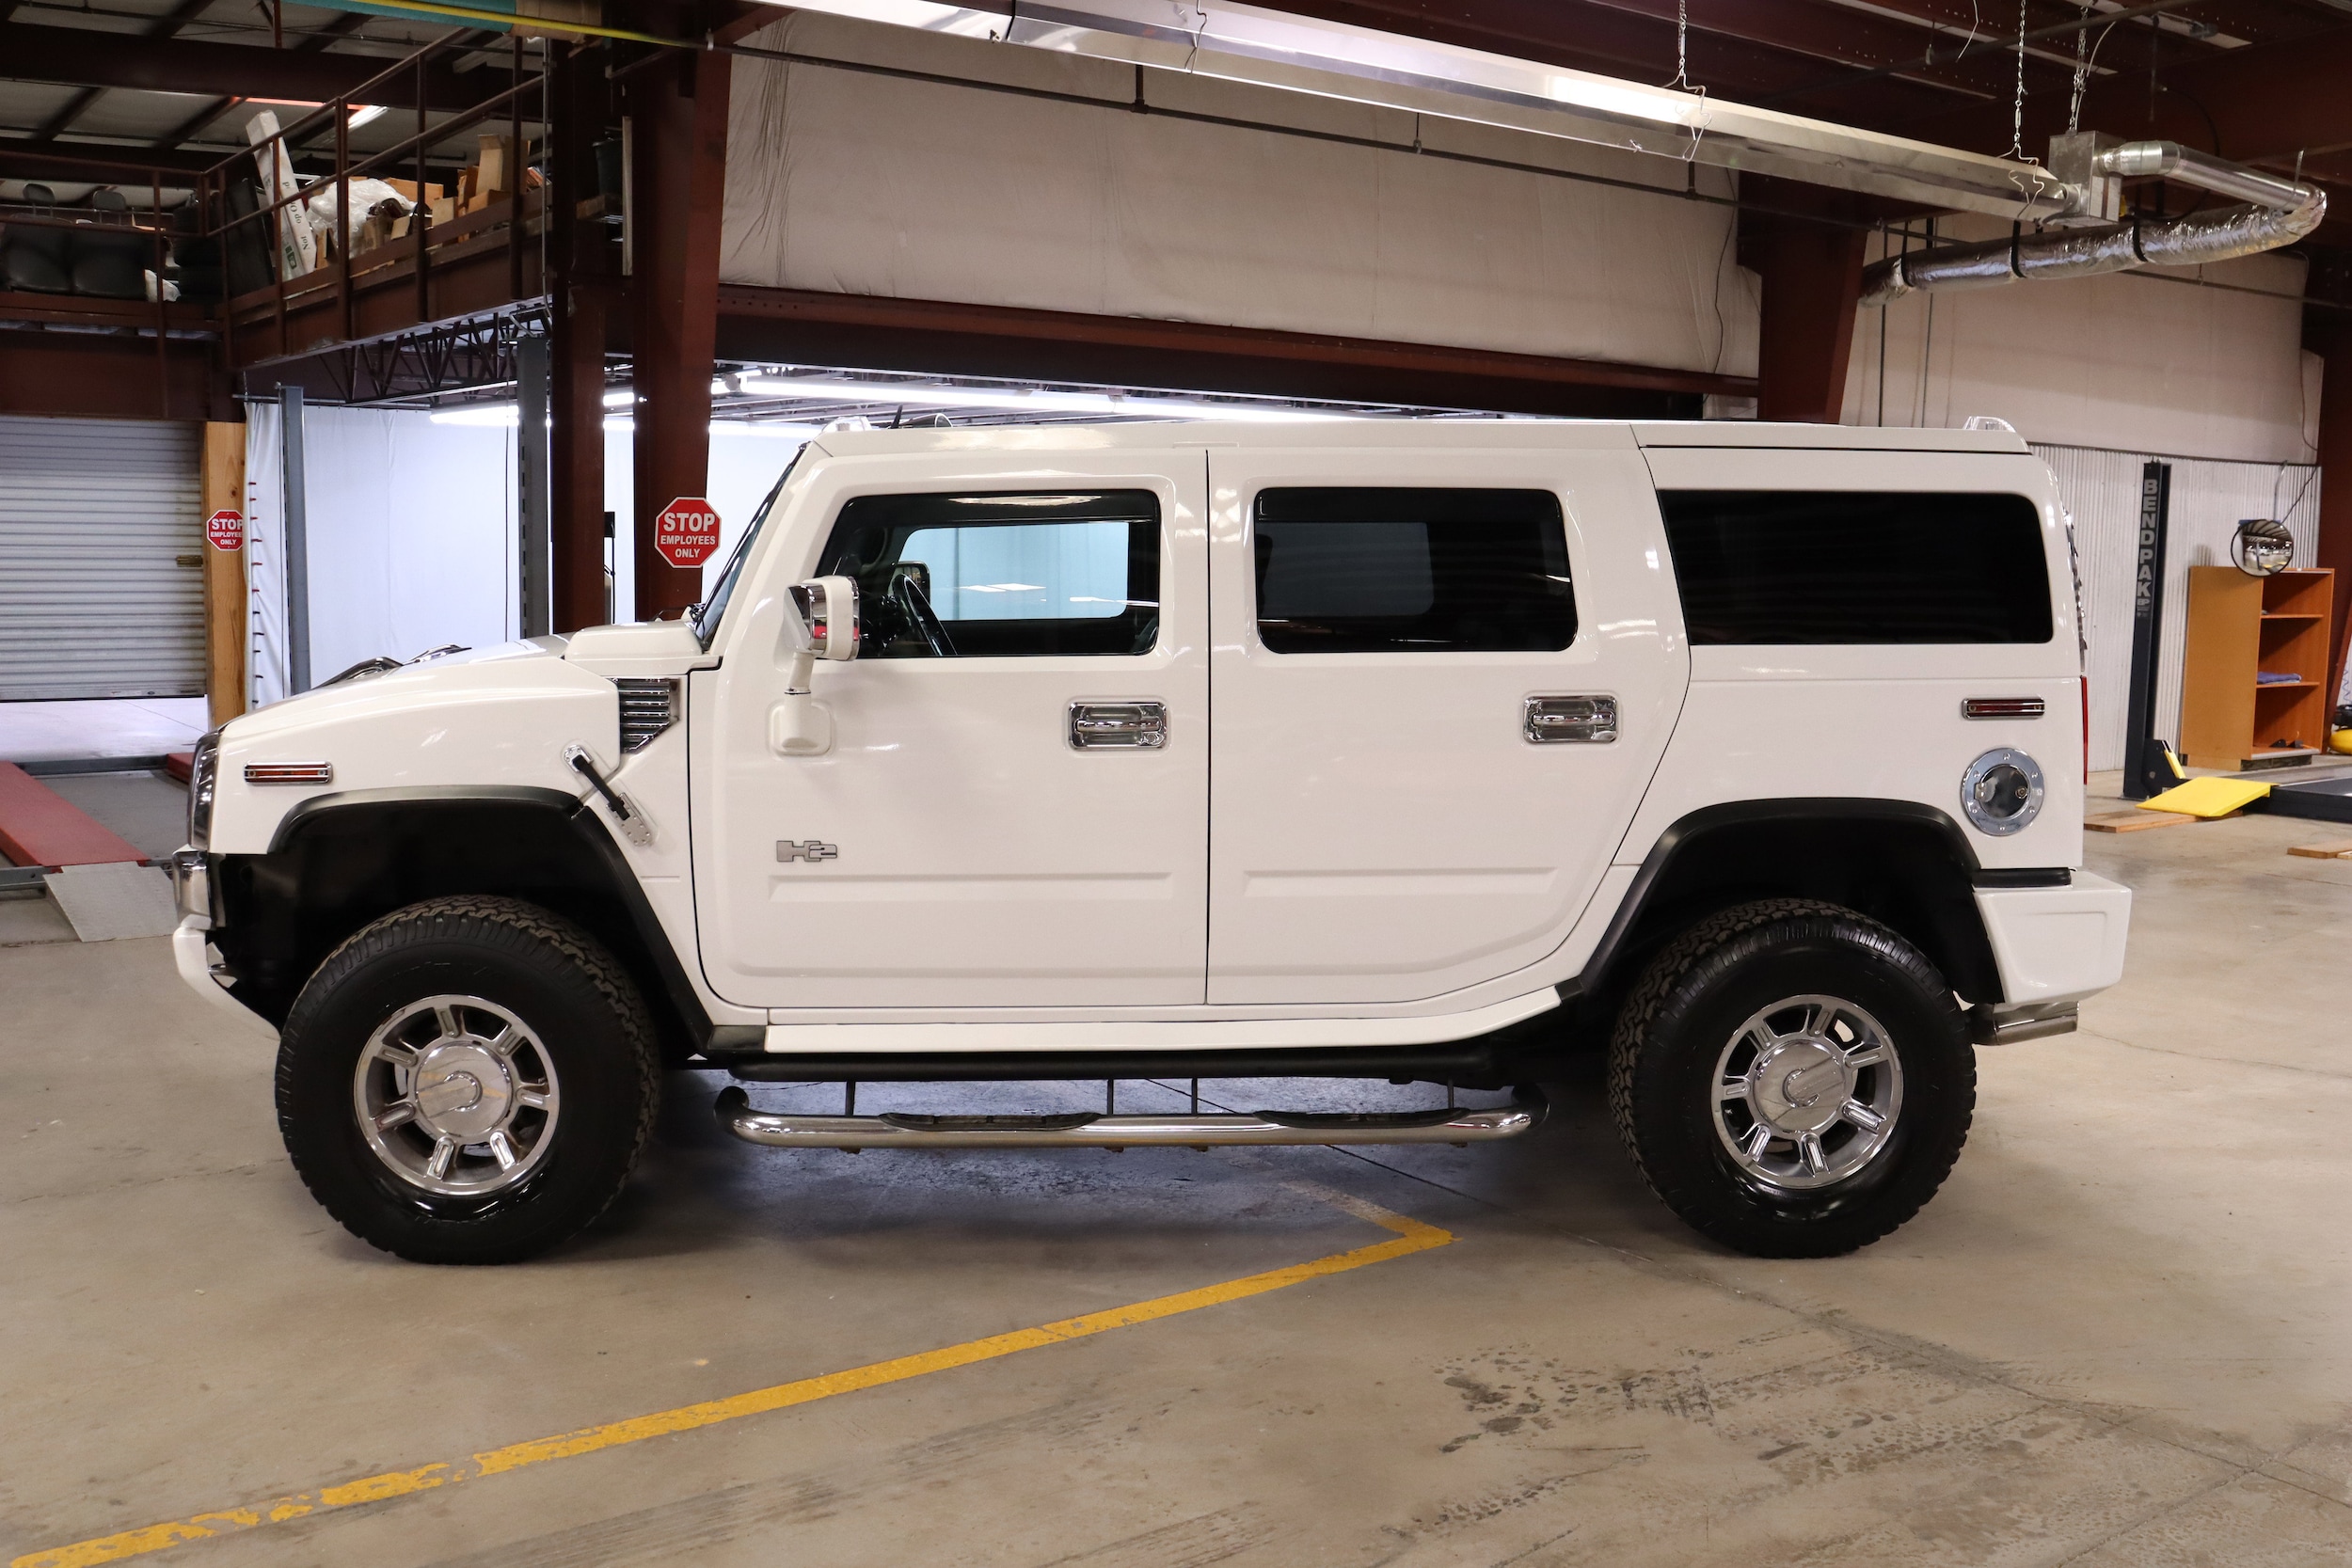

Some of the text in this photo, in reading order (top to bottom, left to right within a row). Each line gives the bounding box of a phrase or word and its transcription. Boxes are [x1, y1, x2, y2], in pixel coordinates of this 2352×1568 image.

[211, 518, 243, 531] STOP
[663, 512, 716, 532] STOP
[660, 535, 716, 546] EMPLOYEES
[2137, 479, 2158, 597] BENDPAK
[675, 548, 701, 558] ONLY
[776, 840, 838, 863] H2
